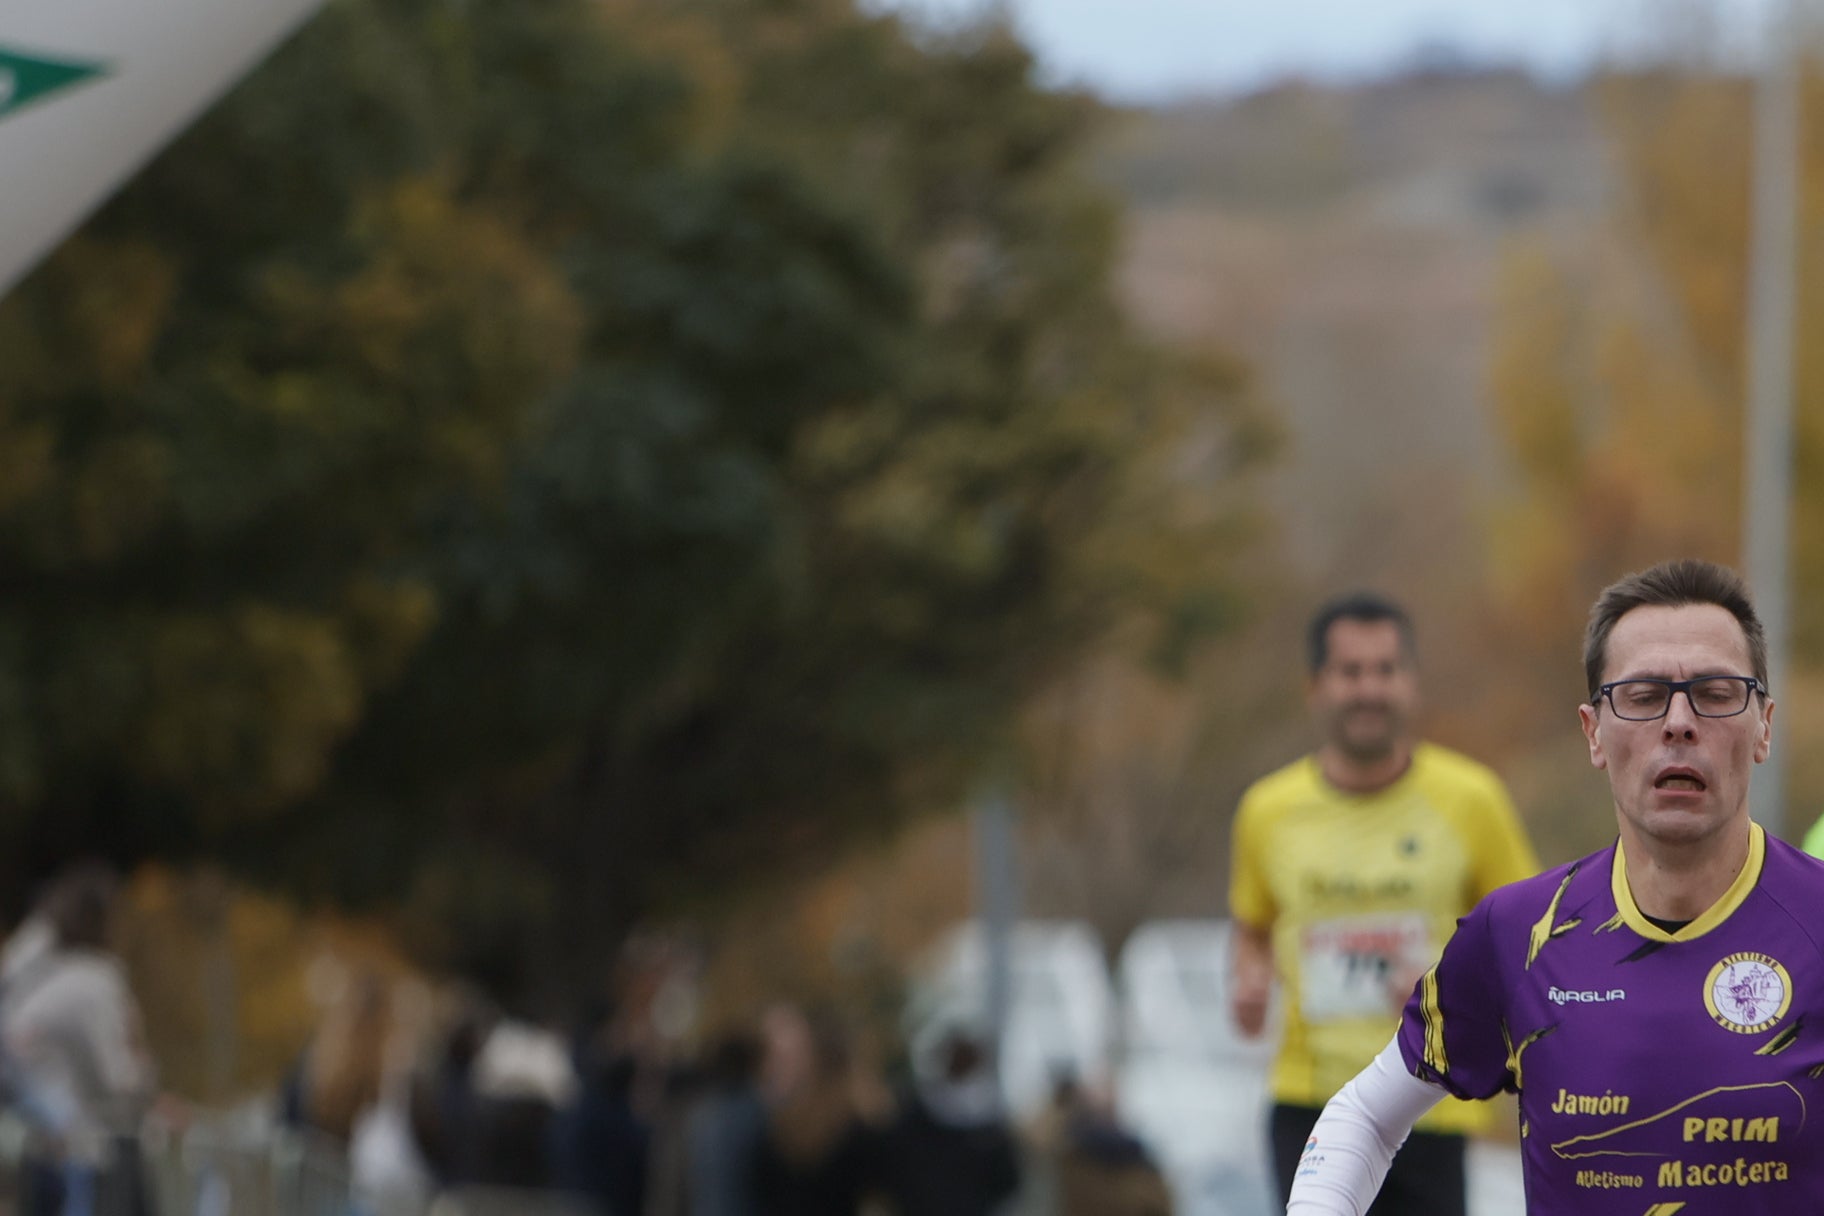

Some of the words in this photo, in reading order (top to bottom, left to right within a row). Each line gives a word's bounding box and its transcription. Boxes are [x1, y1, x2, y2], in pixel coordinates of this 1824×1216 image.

[1551, 1088, 1630, 1116] Jamón
[1683, 1116, 1779, 1143] PRIM
[1575, 1170, 1644, 1190] Atletismo
[1657, 1157, 1789, 1188] Macotera
